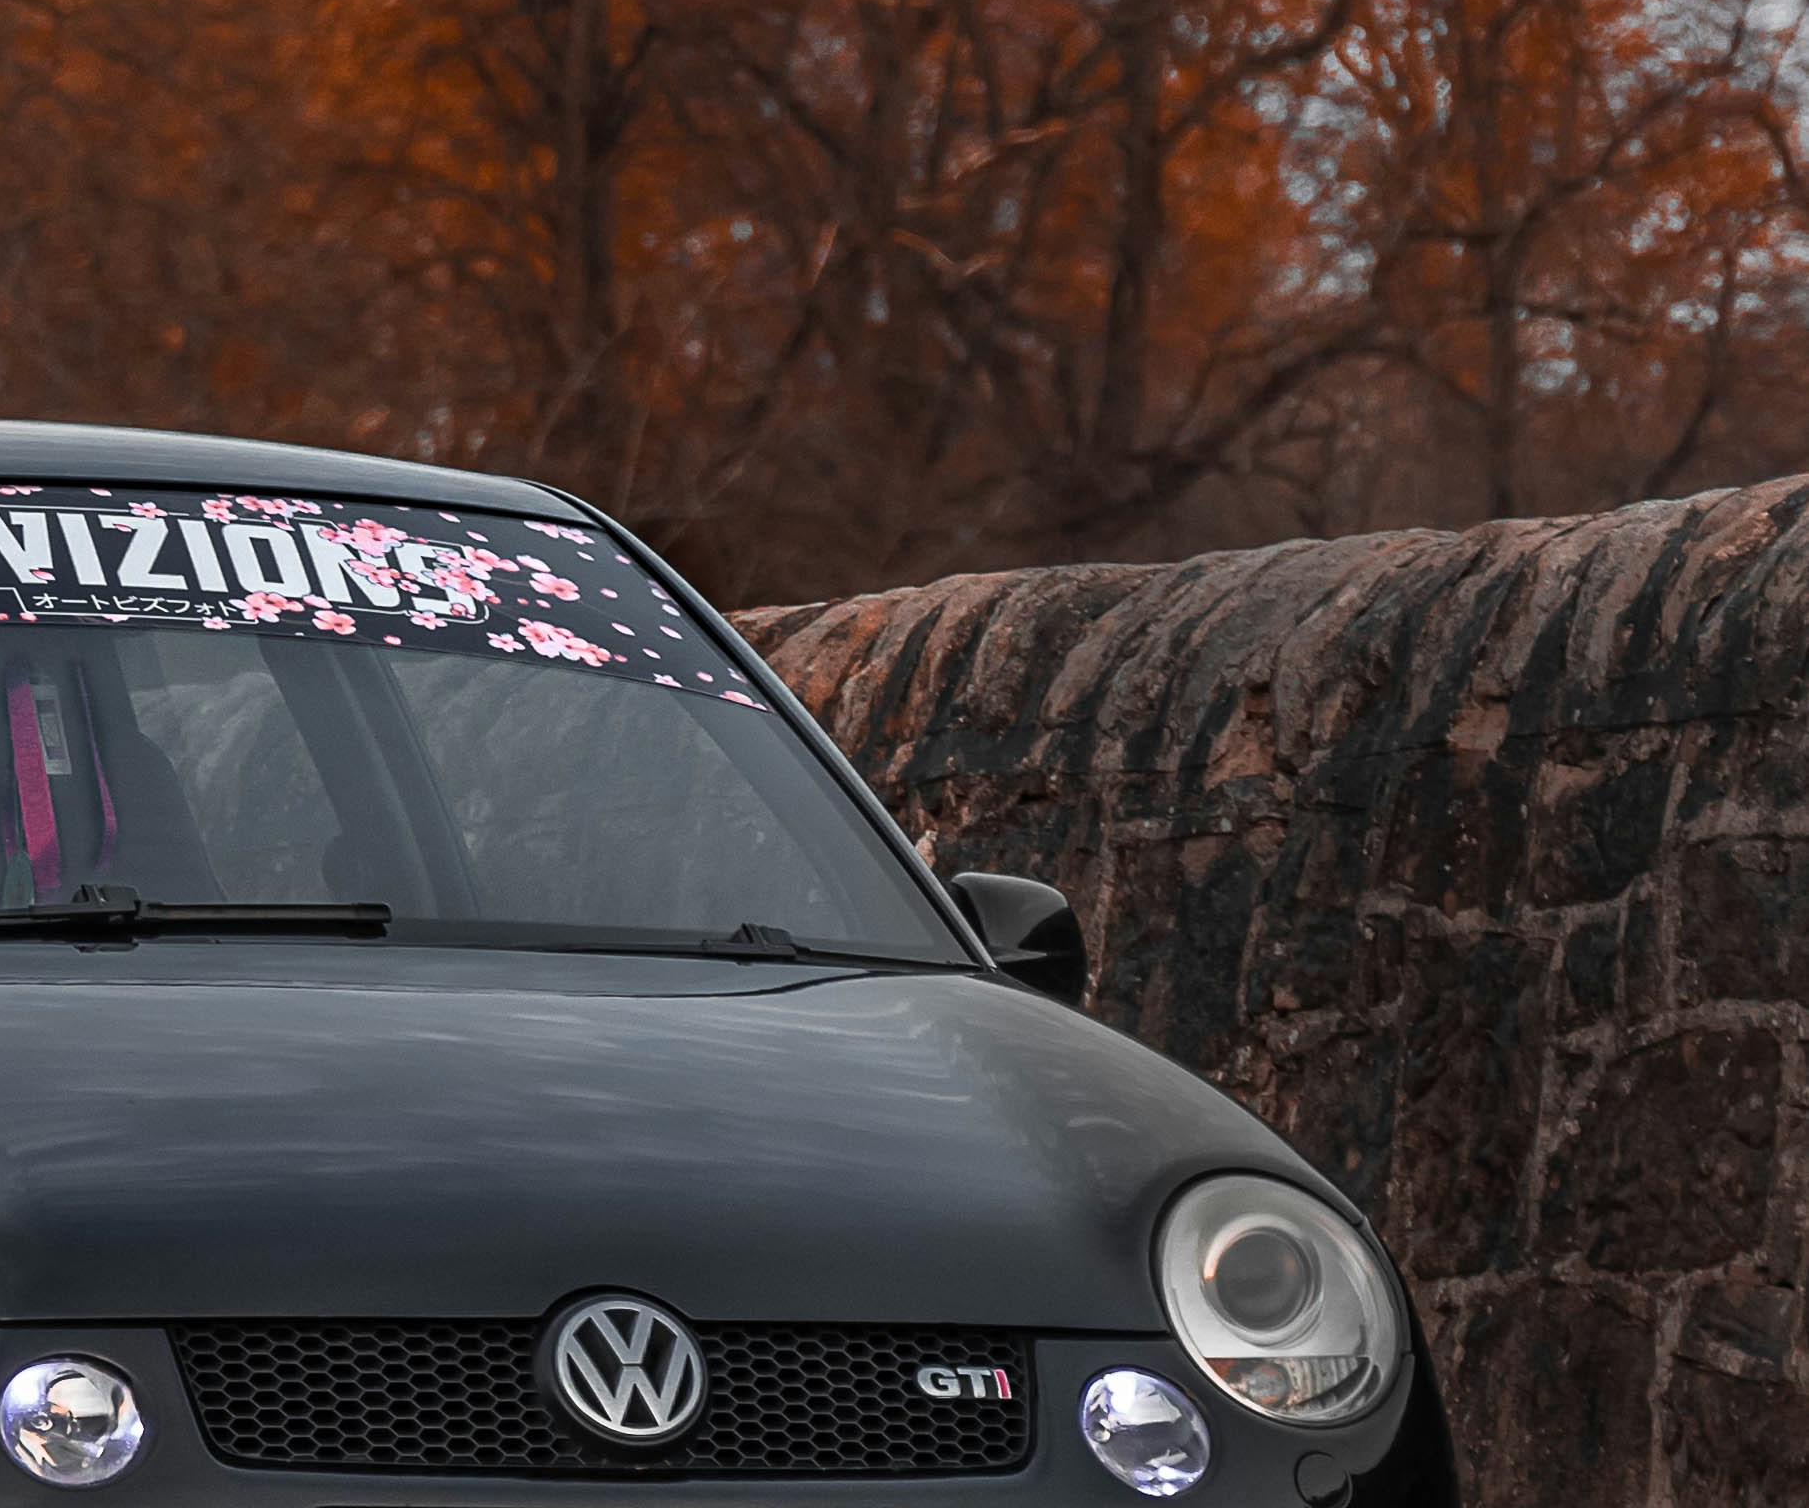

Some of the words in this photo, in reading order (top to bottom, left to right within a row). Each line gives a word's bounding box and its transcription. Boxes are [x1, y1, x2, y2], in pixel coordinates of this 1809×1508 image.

[32, 593, 238, 617] オートビズフォト
[557, 1299, 702, 1436] VW
[916, 1366, 1012, 1400] GTI
